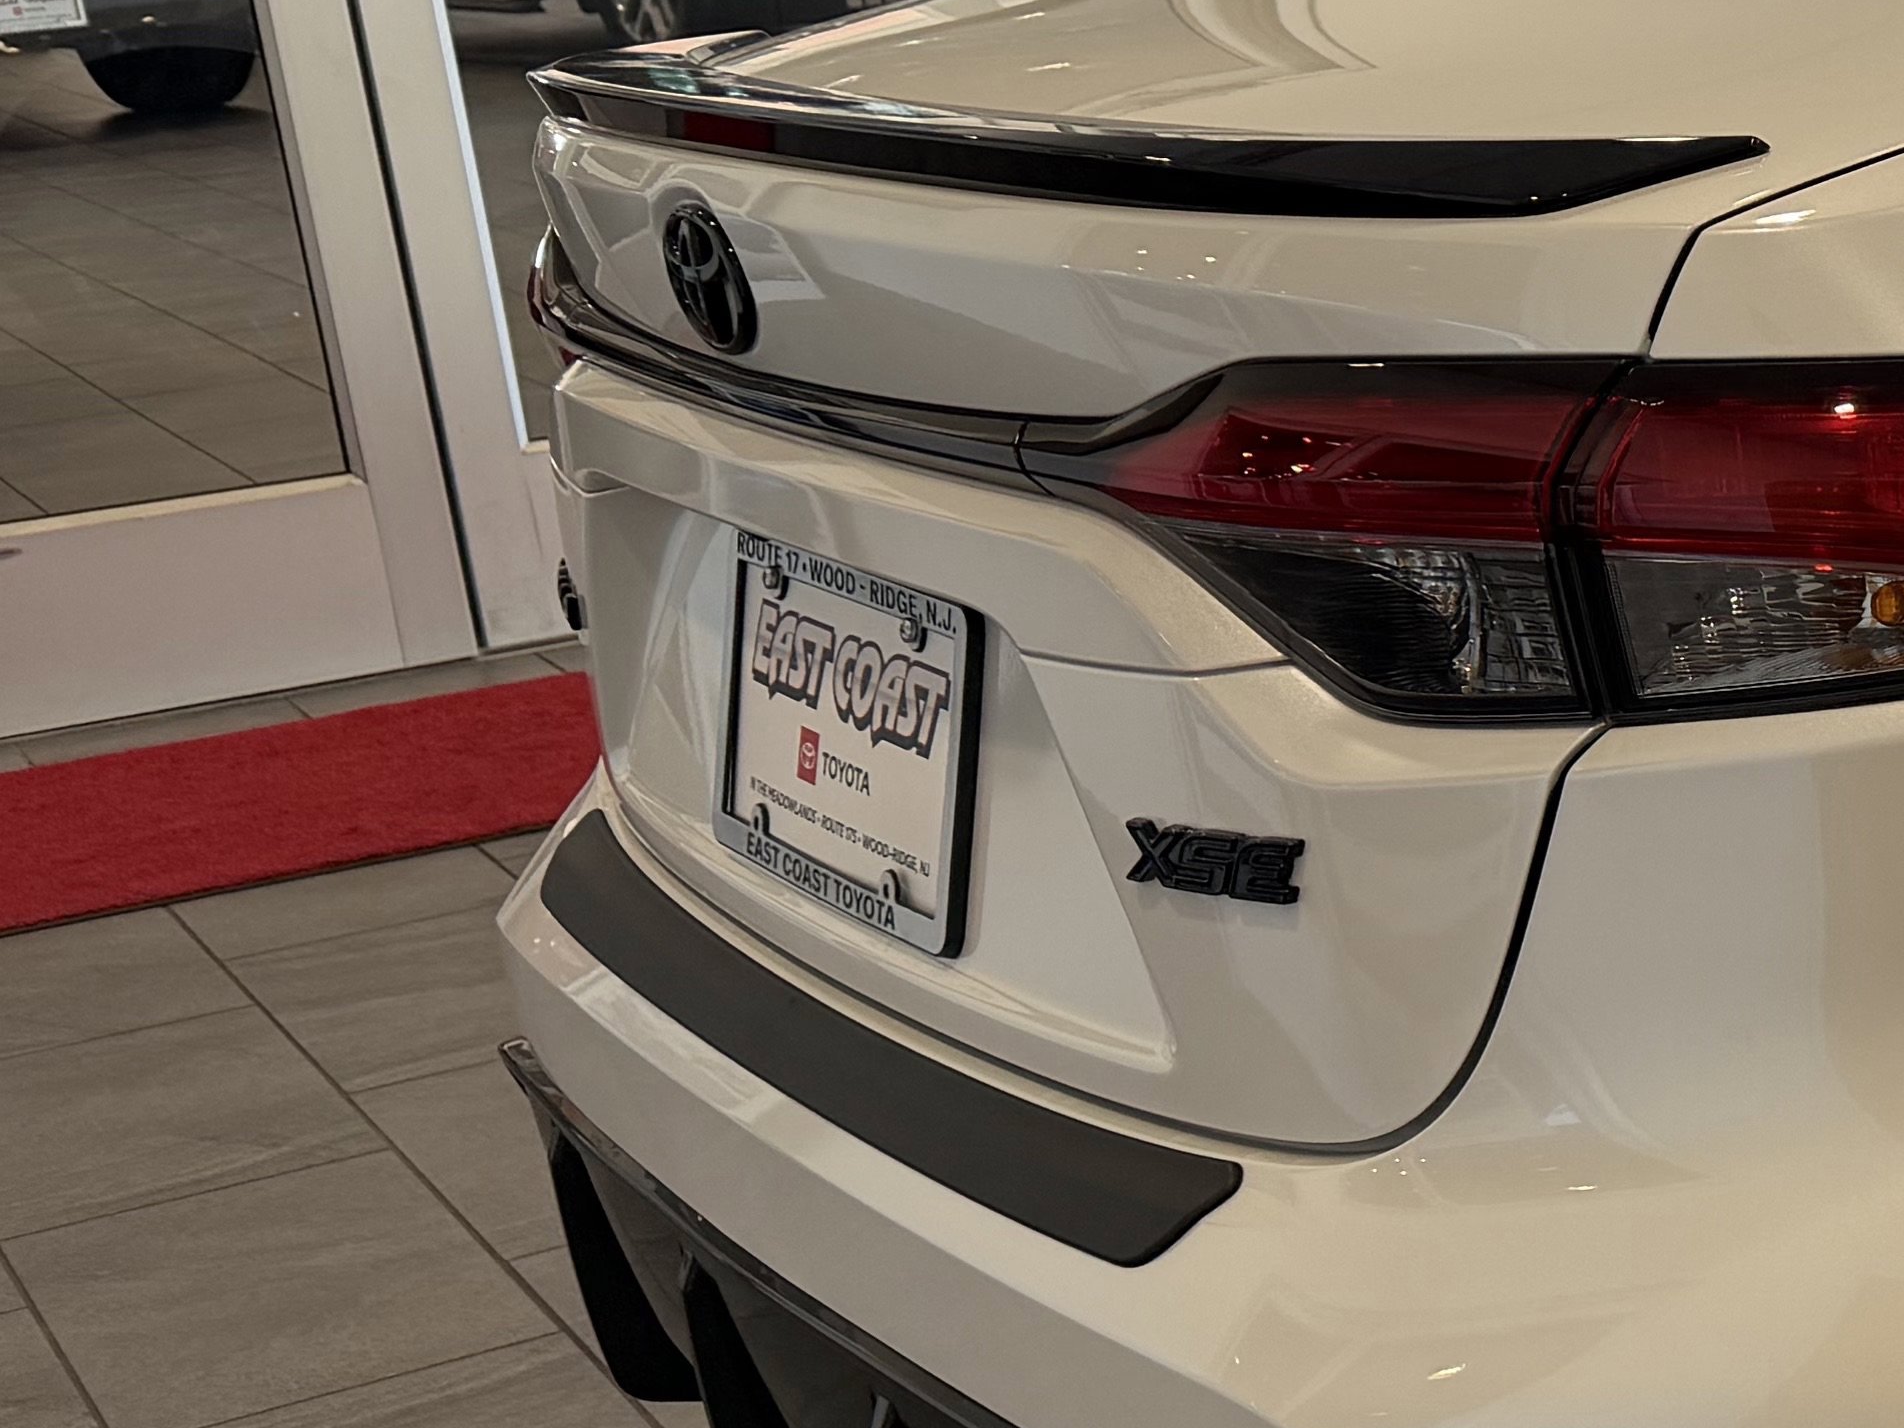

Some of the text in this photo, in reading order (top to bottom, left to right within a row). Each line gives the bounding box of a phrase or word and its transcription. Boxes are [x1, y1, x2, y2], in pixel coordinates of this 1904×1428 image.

[737, 531, 957, 634] ROUTE 17 WOOD RIDGE, N.J.
[752, 598, 952, 759] EAST COAST
[822, 751, 871, 796] TOYOTA
[768, 784, 817, 824] MEADOWLANDS
[820, 814, 845, 839] ROUTE
[862, 833, 919, 875] WOOD-RIDGE,
[920, 858, 931, 878] NJ
[1126, 817, 1305, 905] XSE
[746, 831, 896, 931] EAST COAST TOYOTA
